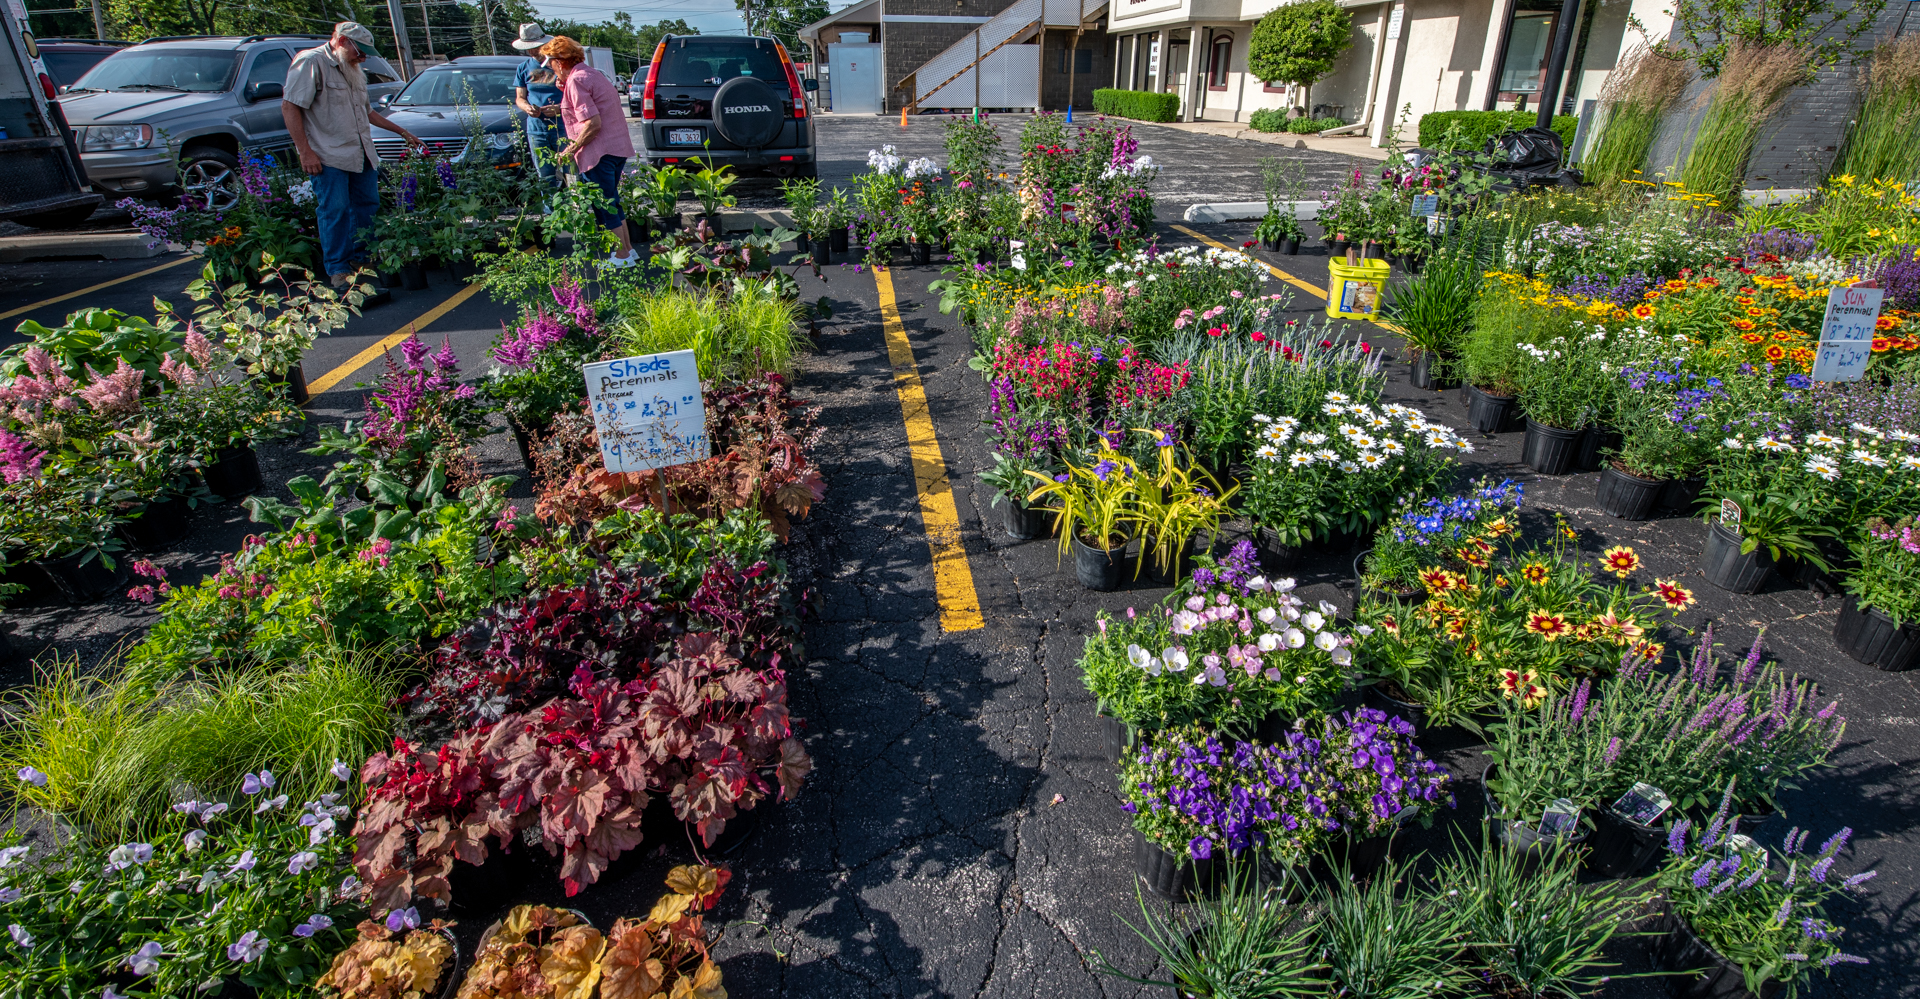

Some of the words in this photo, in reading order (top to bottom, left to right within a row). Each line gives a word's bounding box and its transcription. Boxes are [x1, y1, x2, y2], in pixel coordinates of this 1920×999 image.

[724, 104, 772, 114] HONDA
[1842, 288, 1868, 306] SUN
[1831, 304, 1874, 316] Perennials
[609, 356, 670, 378] Shade
[601, 370, 677, 389] Perennials
